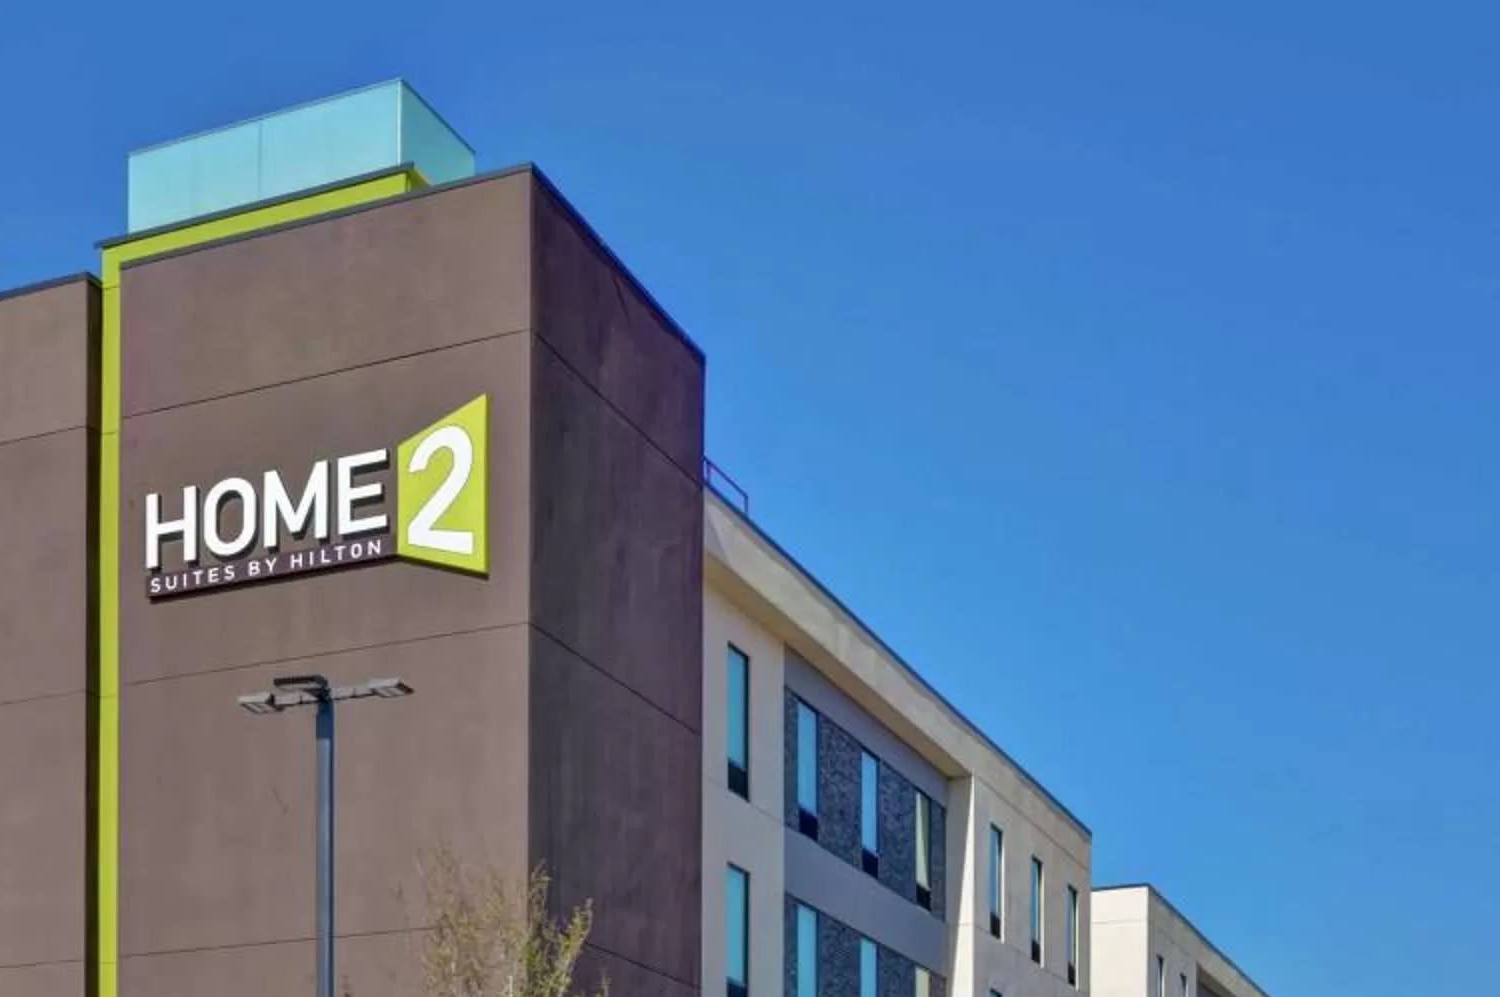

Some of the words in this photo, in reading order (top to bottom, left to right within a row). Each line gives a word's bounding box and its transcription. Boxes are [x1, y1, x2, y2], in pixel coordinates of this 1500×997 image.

[150, 564, 236, 594] SUITES
[247, 556, 277, 578] BY
[289, 538, 383, 570] HILTON
